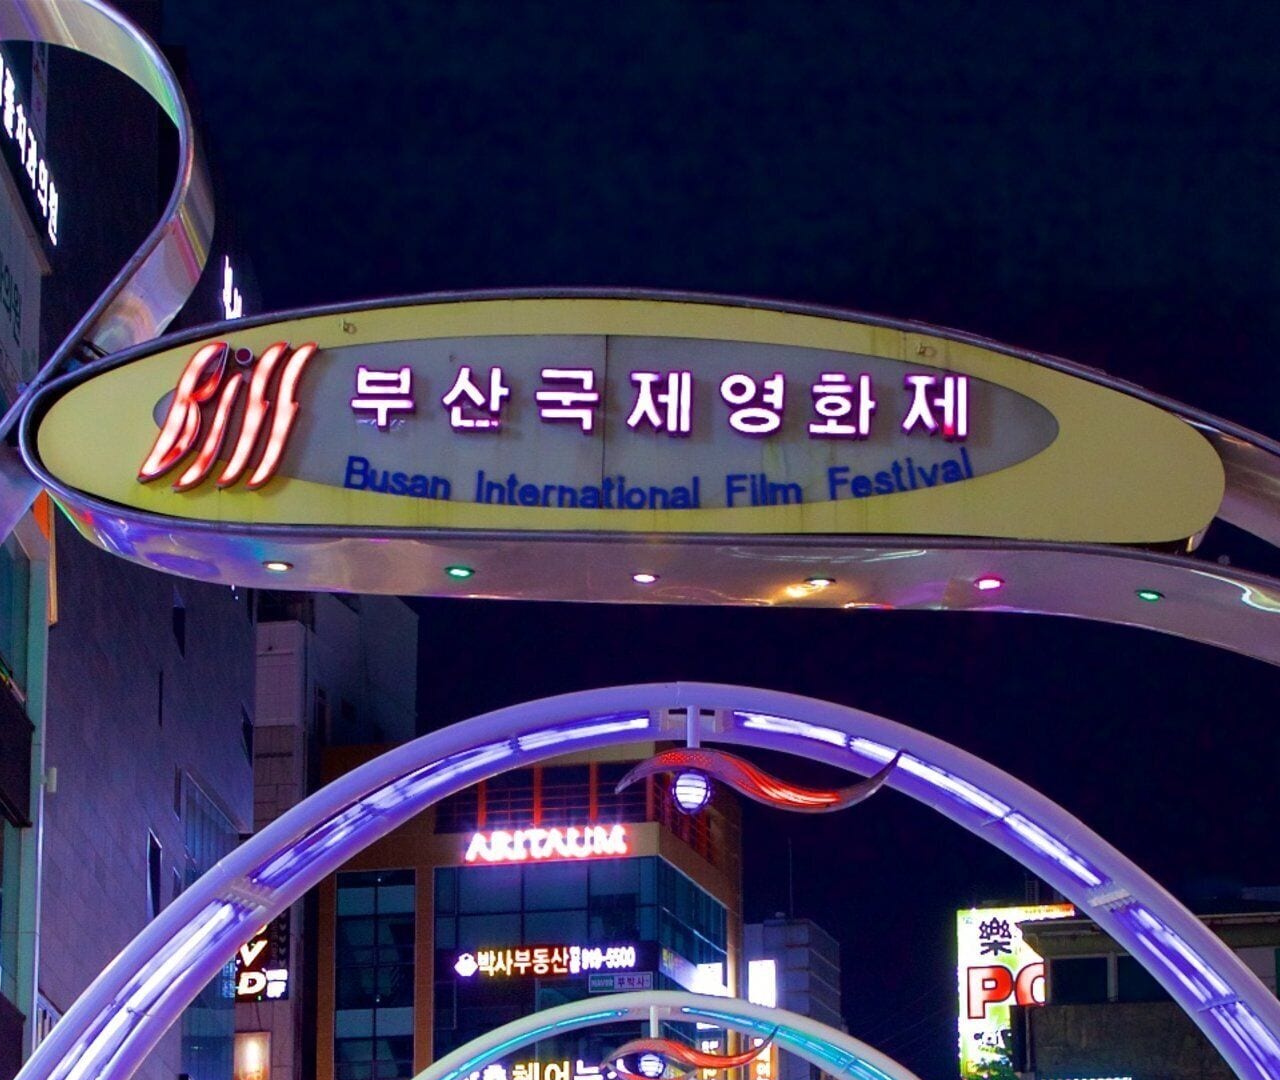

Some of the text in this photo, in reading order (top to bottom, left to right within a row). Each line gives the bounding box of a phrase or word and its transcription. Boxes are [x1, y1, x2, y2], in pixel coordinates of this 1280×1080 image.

[350, 363, 971, 440] 부산국제영화제
[344, 447, 974, 510] Busan International Film Festival
